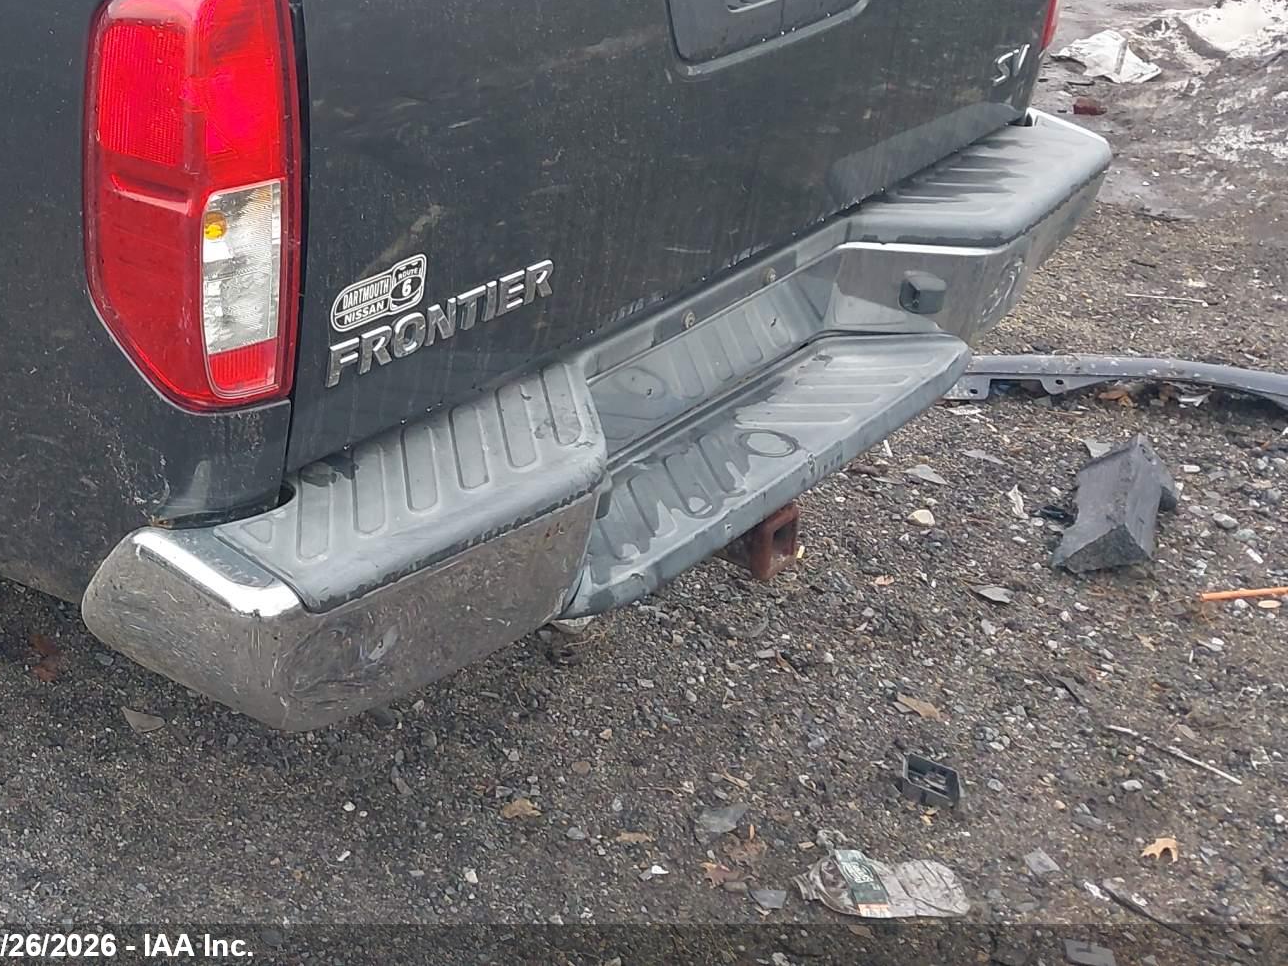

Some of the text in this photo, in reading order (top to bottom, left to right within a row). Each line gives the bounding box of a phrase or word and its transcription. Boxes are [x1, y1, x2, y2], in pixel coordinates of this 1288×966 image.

[398, 267, 419, 281] ROUTE
[343, 277, 391, 310] DARTMOUTH
[401, 278, 412, 297] 6
[325, 259, 555, 388] FRONTIER
[344, 300, 385, 325] NISSAN
